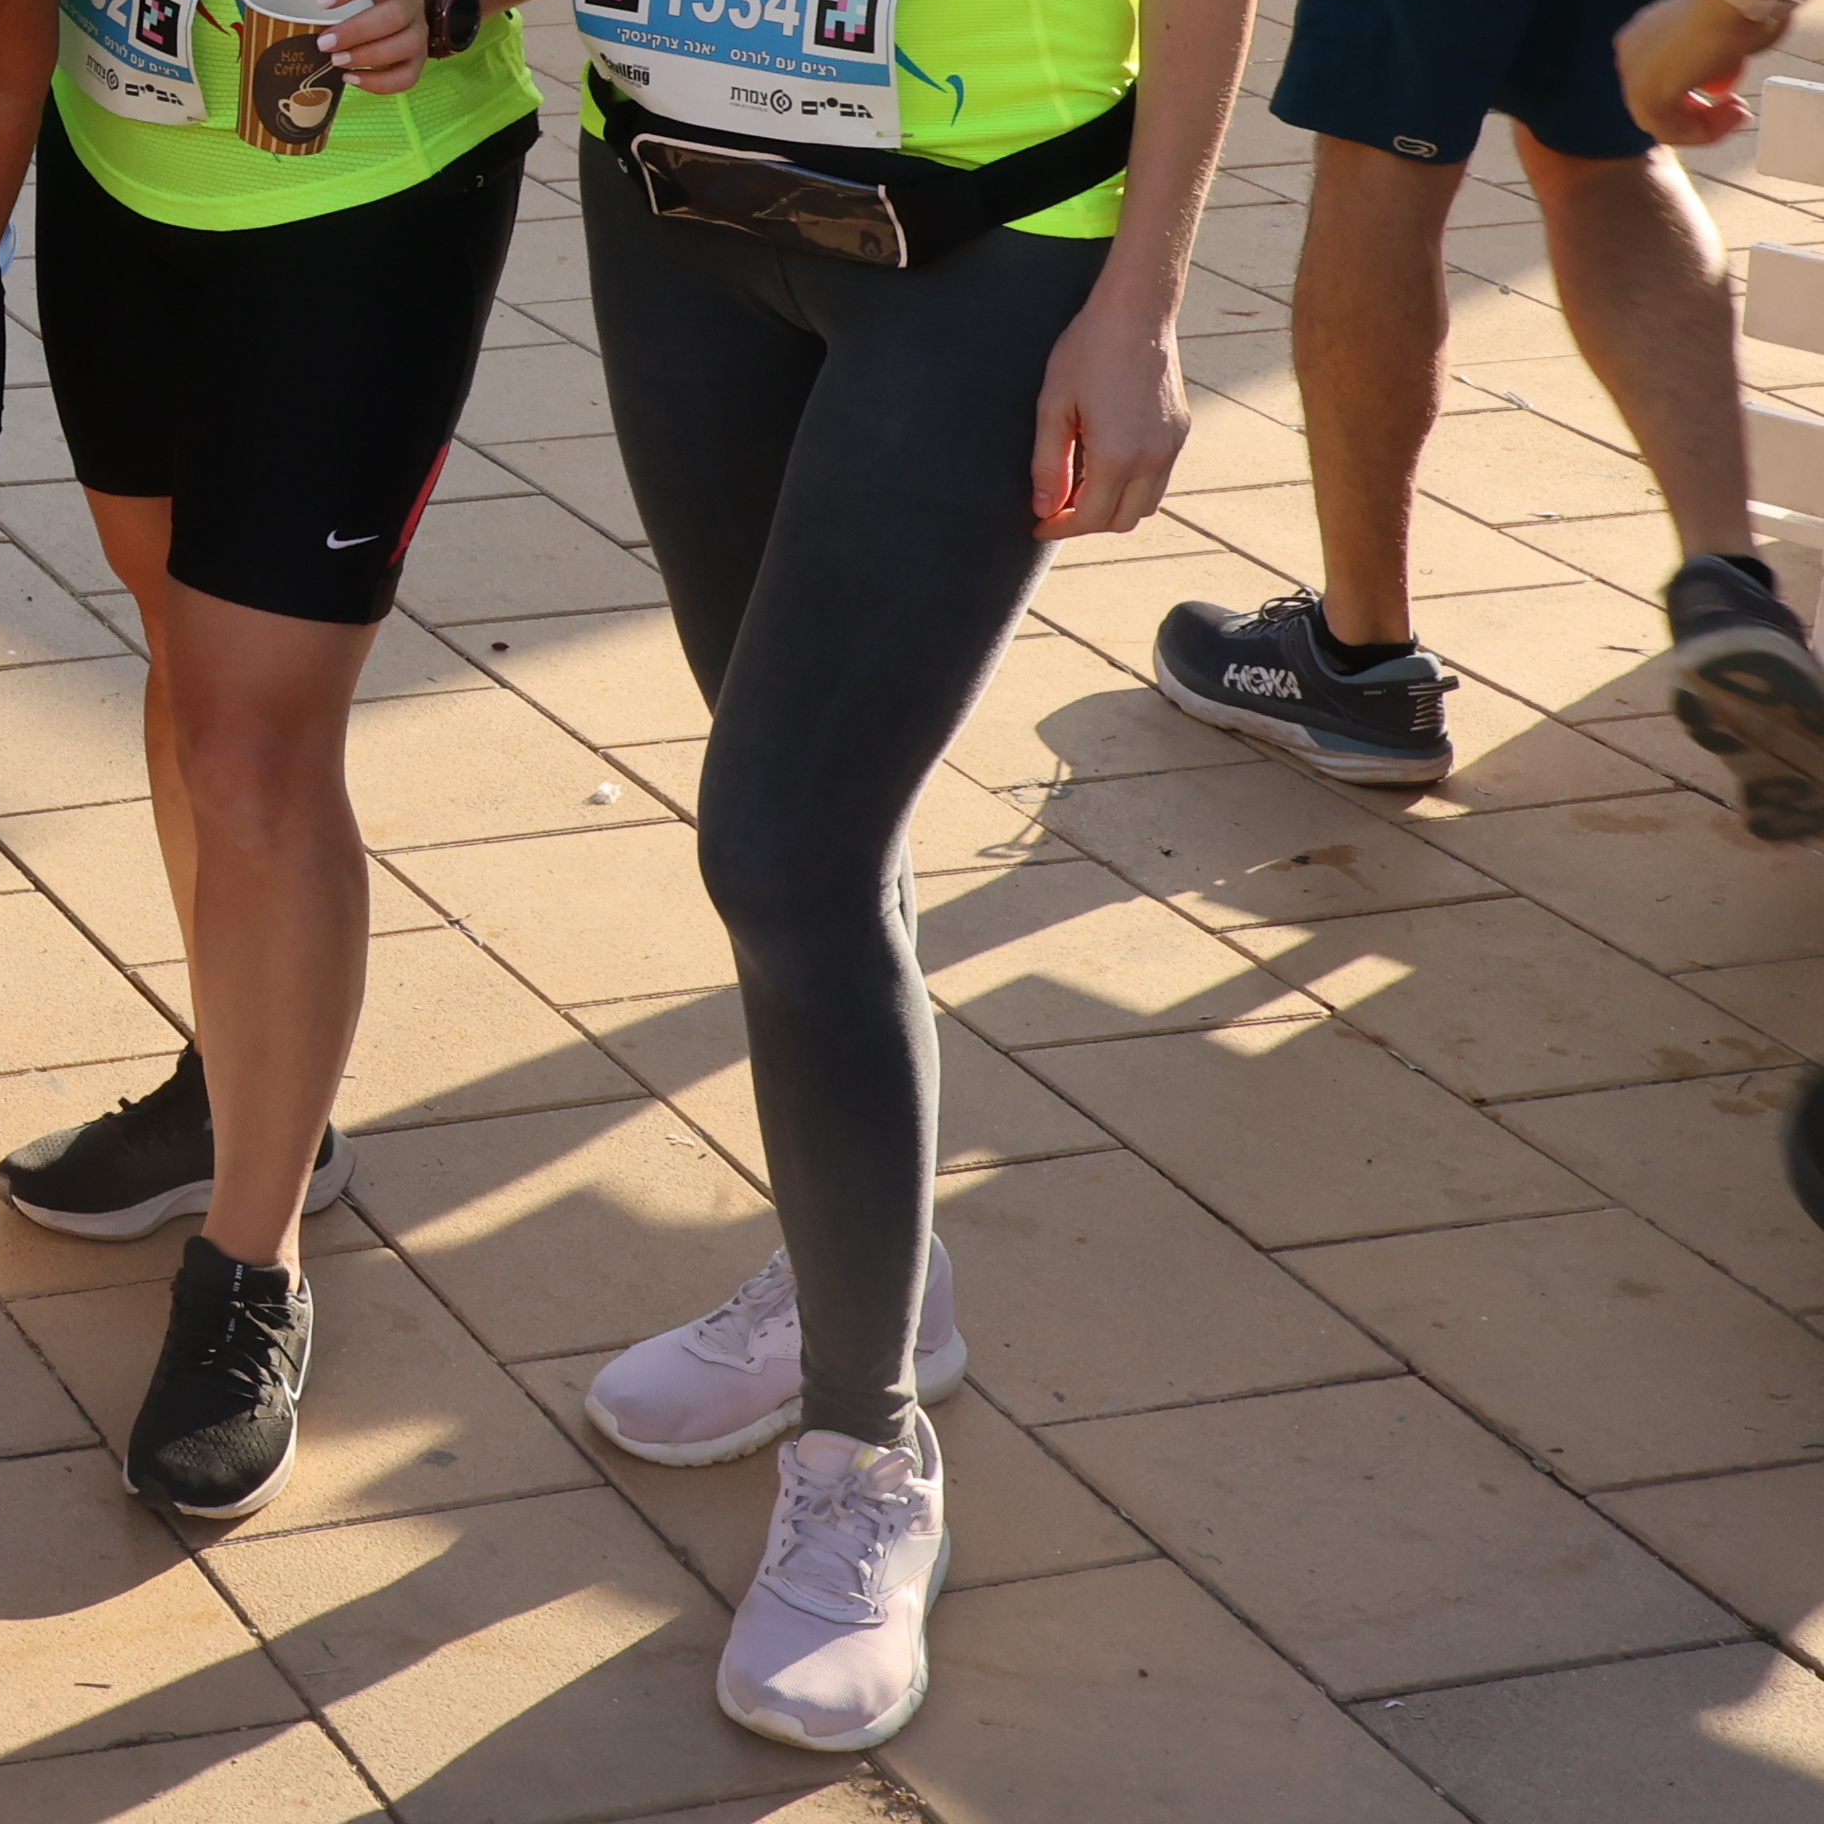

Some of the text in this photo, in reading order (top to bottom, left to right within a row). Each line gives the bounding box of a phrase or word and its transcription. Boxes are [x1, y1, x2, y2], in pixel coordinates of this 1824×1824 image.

[104, 37, 129, 56] לורנס
[280, 48, 305, 63] Hot
[615, 25, 838, 78] רצים עם לורנס יאנה צרקינסקי
[130, 55, 147, 69] עם
[273, 61, 315, 76] Coffee
[729, 85, 768, 104] צמרת
[1221, 662, 1301, 701] HOKA
